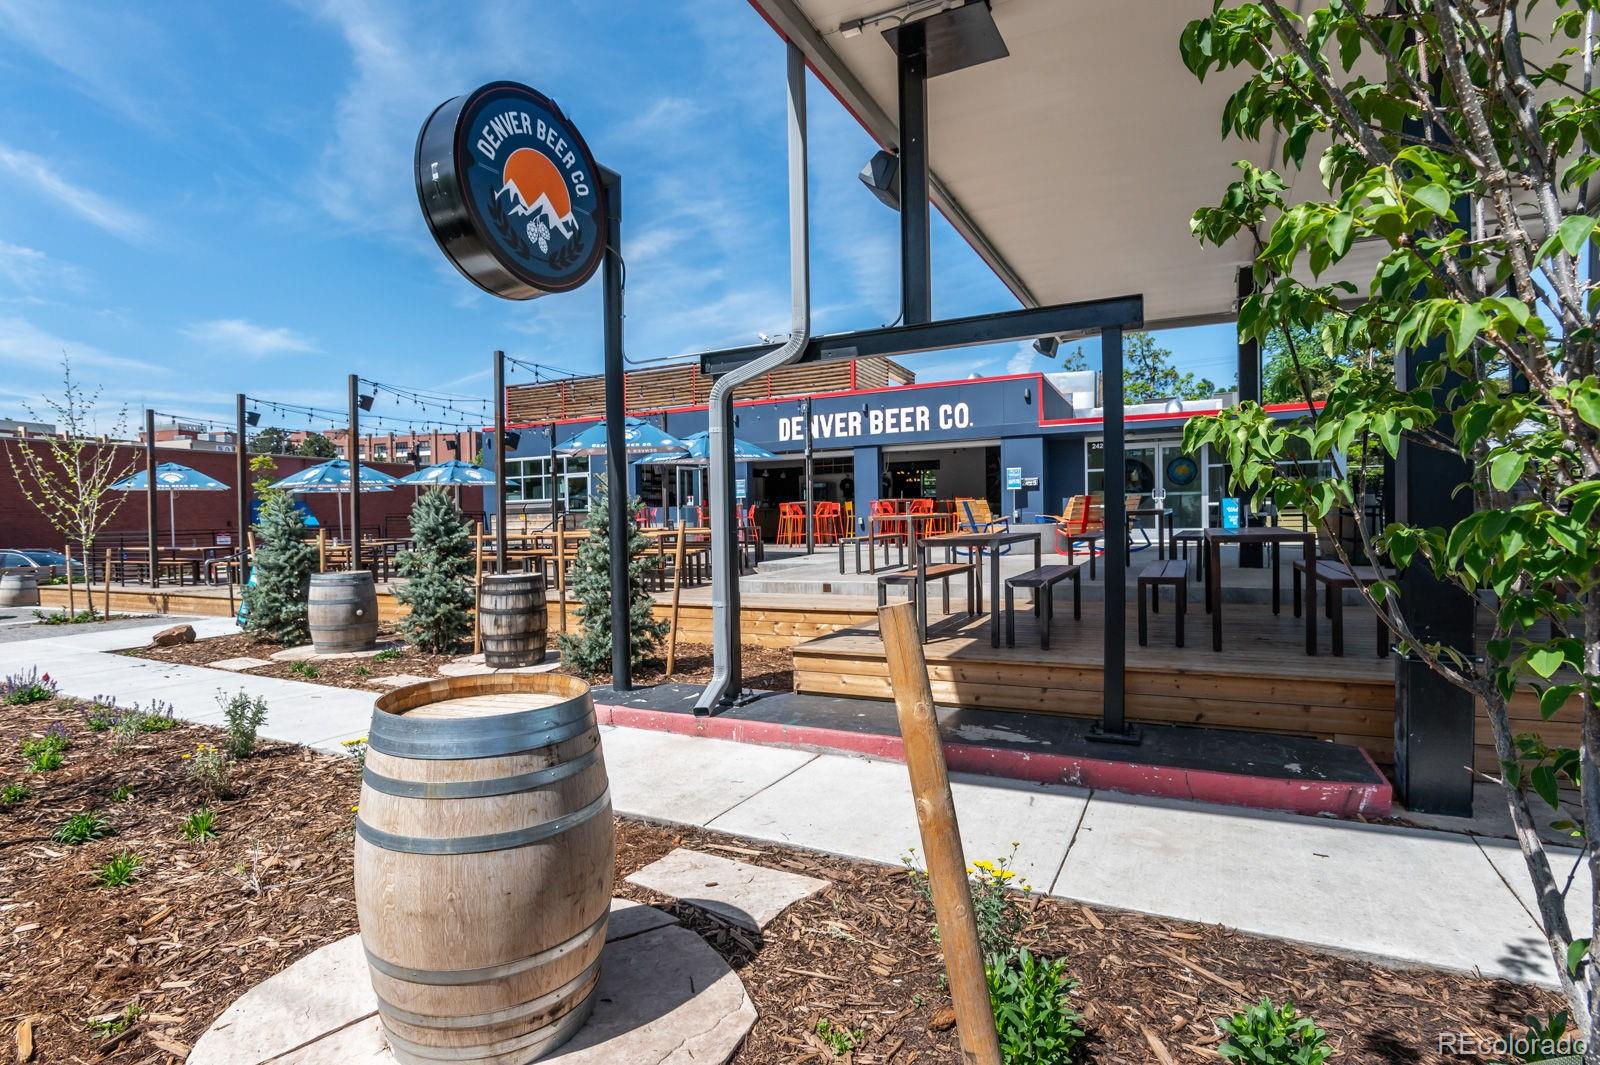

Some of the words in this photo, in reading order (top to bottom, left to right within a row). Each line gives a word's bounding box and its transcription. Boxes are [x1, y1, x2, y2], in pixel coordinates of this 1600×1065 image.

[477, 111, 532, 160] DENVER
[536, 119, 576, 169] BEER
[778, 411, 862, 441] DENVER
[869, 405, 930, 435] BEER
[938, 402, 974, 430] CO.
